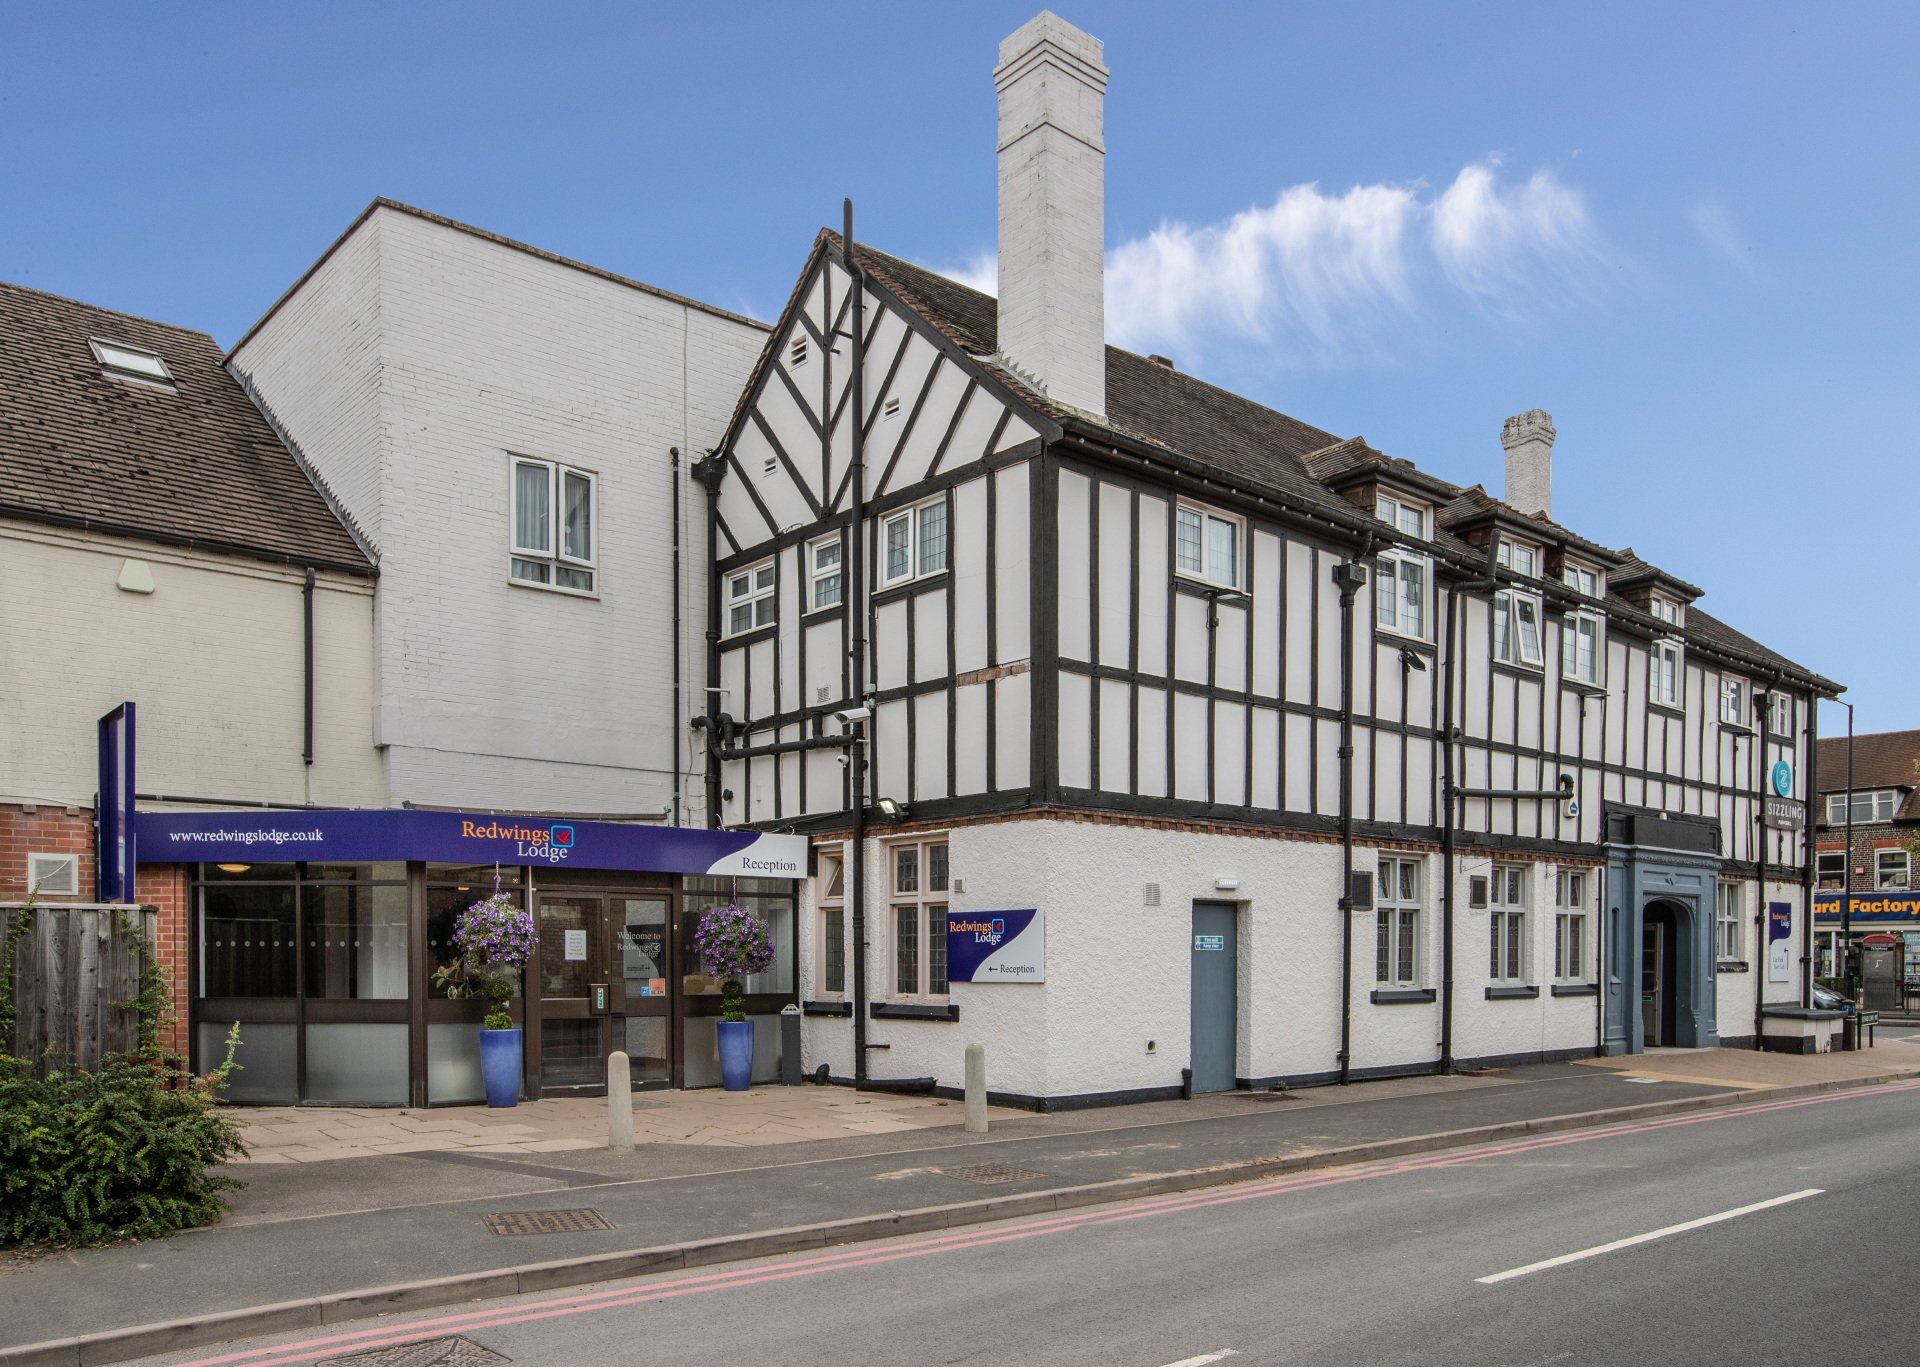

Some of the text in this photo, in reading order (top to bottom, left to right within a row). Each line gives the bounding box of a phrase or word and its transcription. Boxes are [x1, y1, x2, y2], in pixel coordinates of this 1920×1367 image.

[1767, 802, 1802, 820] SIZZLING
[169, 828, 324, 845] www.redwingslodge.co.uk
[461, 819, 550, 846] Redwings
[517, 841, 568, 863] Lodge
[742, 856, 796, 873] Reception
[1849, 898, 1920, 915] Factory
[617, 931, 661, 940] Welcome to
[949, 920, 992, 934] Redwings
[975, 931, 1002, 946] Lodge
[1000, 964, 1035, 975] Reception
